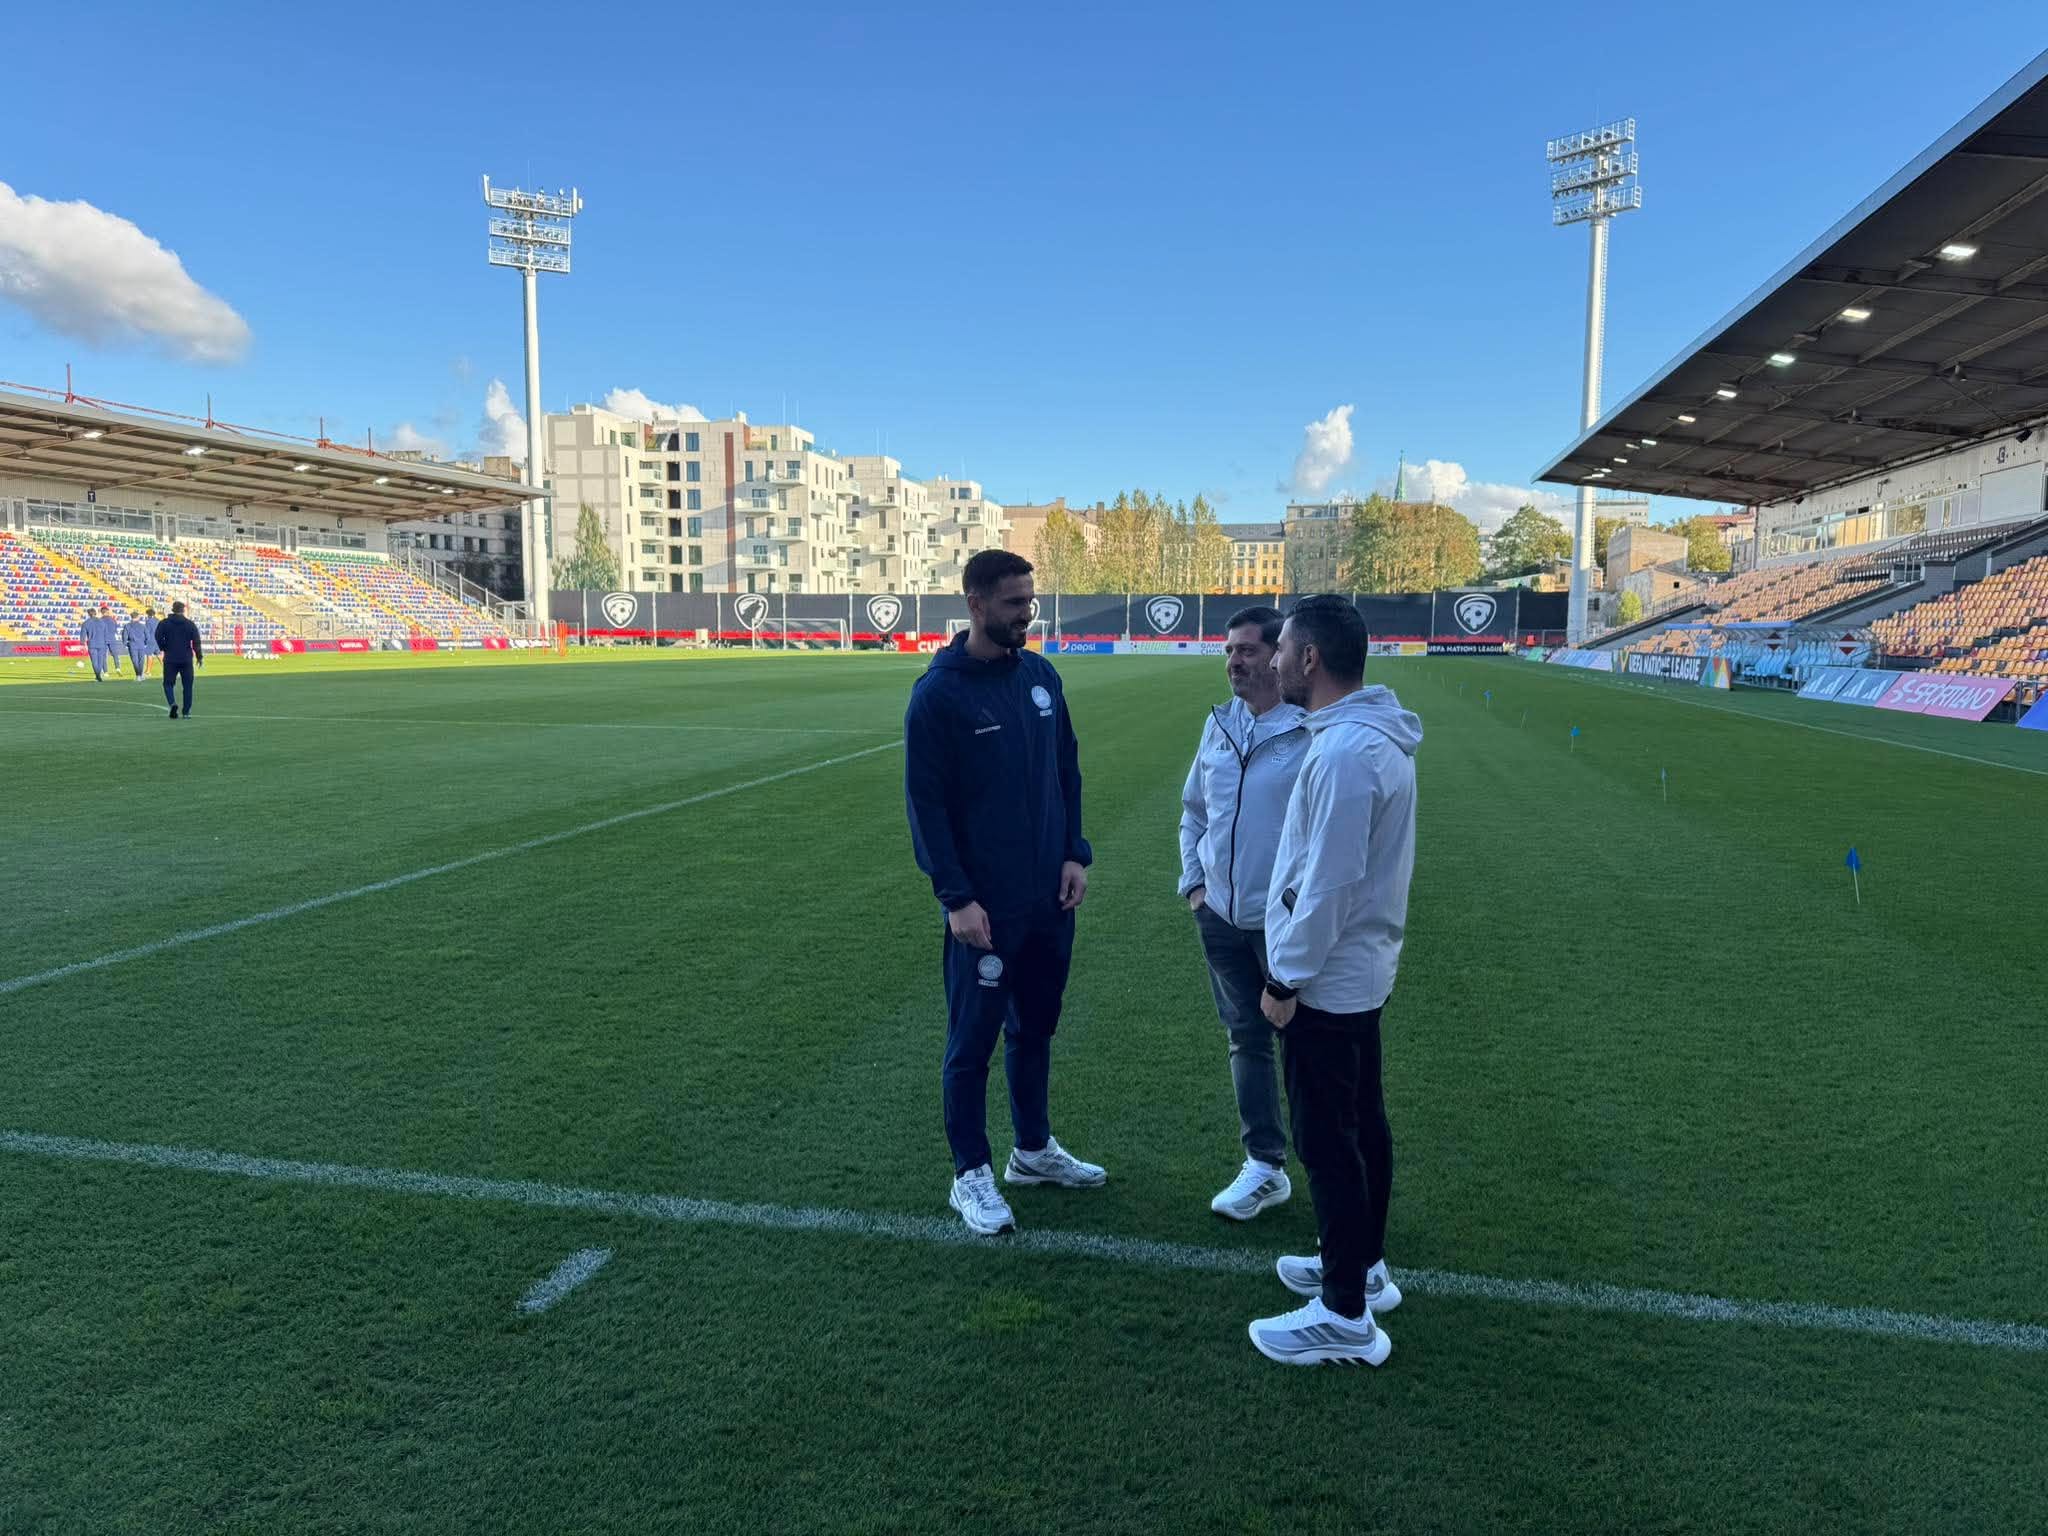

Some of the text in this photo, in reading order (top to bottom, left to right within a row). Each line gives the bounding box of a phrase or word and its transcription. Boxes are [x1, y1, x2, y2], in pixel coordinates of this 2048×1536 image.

[1070, 642, 1096, 653] pepsi
[1446, 645, 1477, 653] NATIONS
[1478, 645, 1504, 653] LEAGUE
[1628, 654, 1643, 673] UEFA
[1643, 655, 1671, 677] NATIONS
[1671, 656, 1701, 681] LEAGUE
